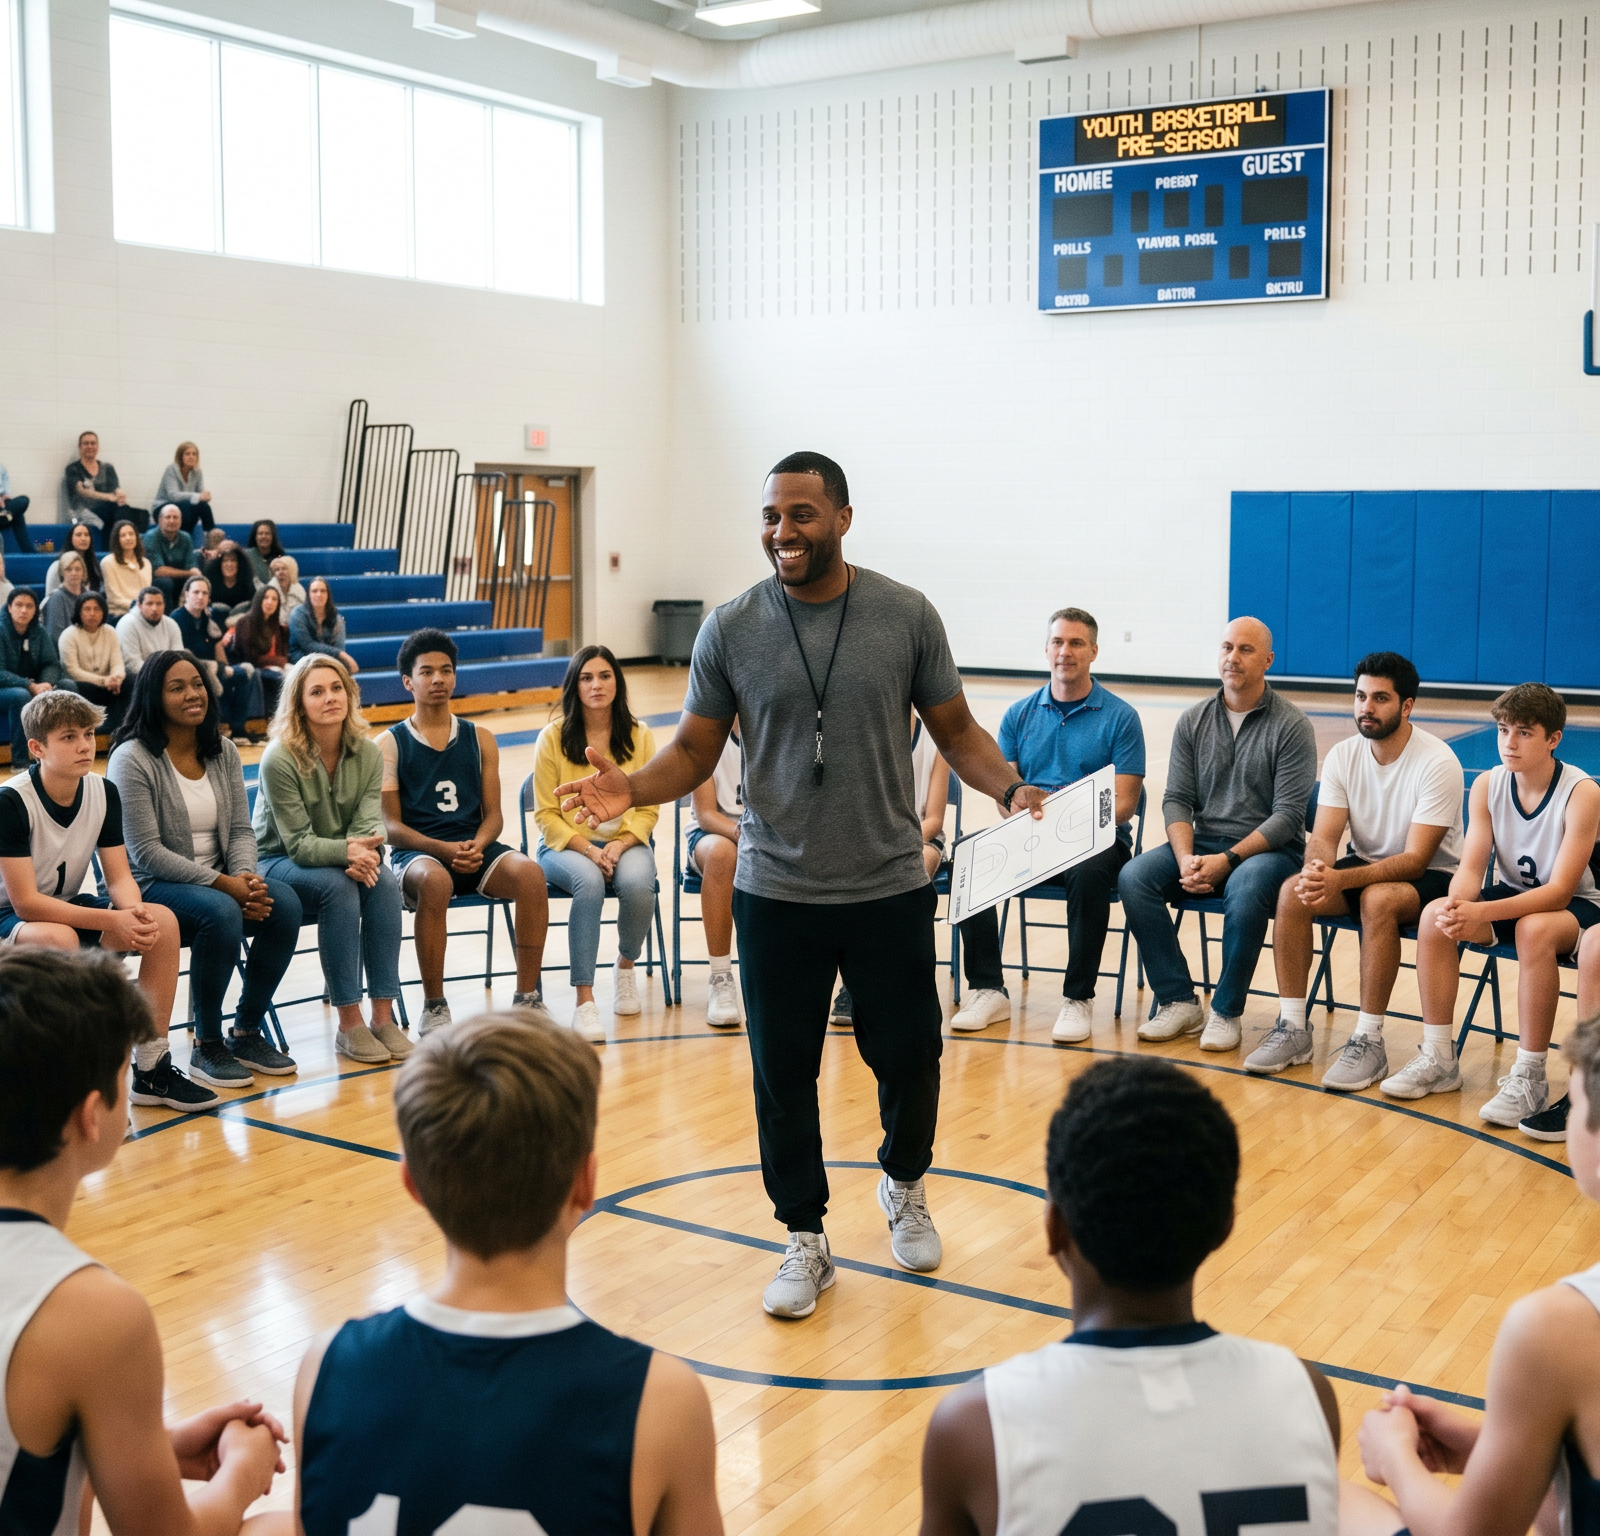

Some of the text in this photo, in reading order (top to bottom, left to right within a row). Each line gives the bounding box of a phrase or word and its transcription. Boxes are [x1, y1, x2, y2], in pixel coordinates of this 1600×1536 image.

[1082, 101, 1276, 139] YOUTH BASKETBALL
[1117, 126, 1239, 158] PRE-SEASON
[1242, 152, 1305, 176] GUEST
[435, 780, 459, 812] 3
[53, 861, 66, 896] 1
